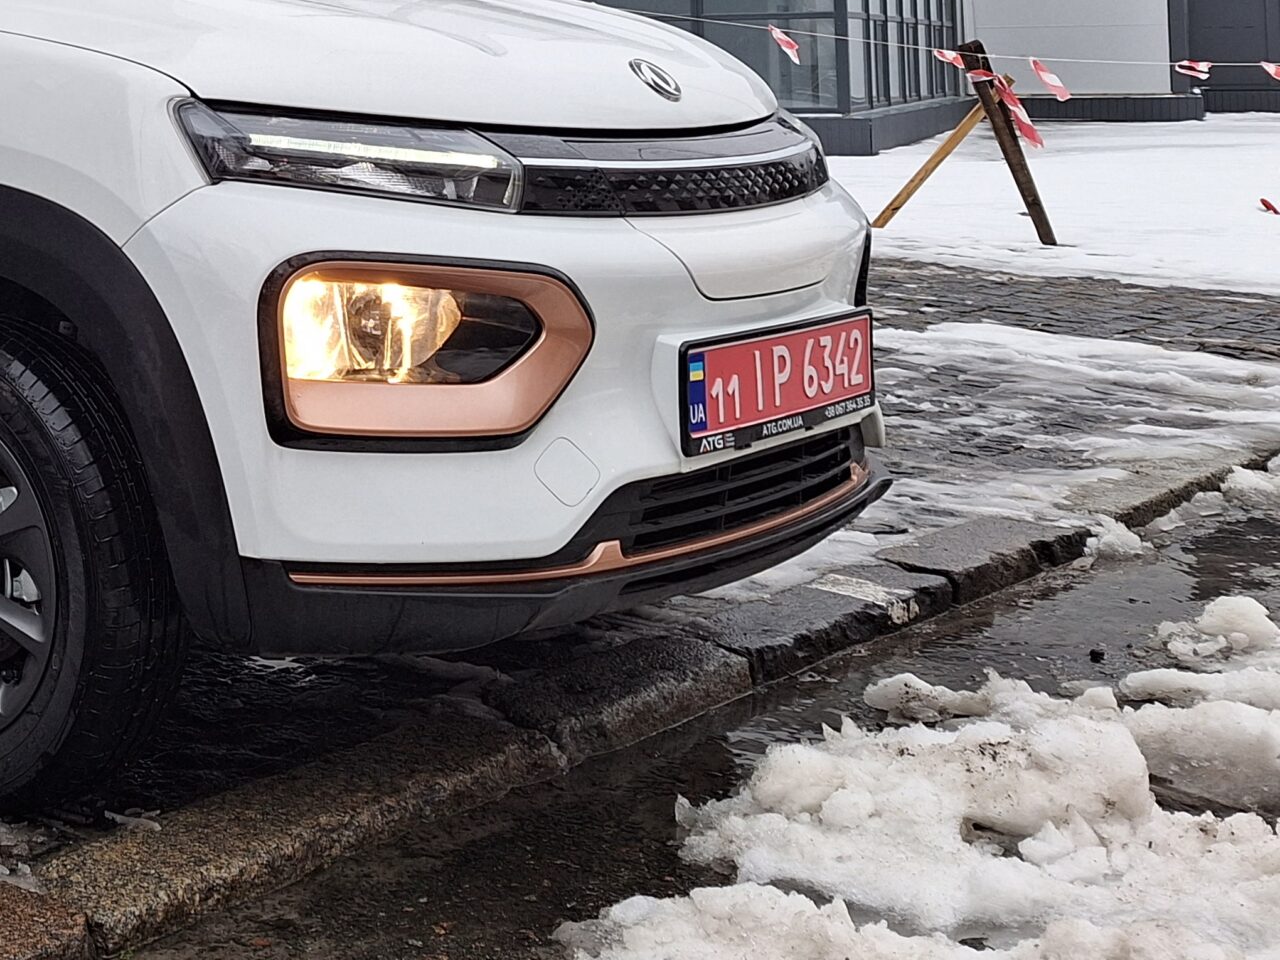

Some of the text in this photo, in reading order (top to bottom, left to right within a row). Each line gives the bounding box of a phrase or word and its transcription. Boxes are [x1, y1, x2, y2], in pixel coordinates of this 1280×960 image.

[690, 403, 706, 424] UA
[710, 374, 741, 424] 11
[803, 329, 864, 399] 6342
[700, 435, 724, 453] ATG
[762, 416, 804, 436] ATG.COM.UA
